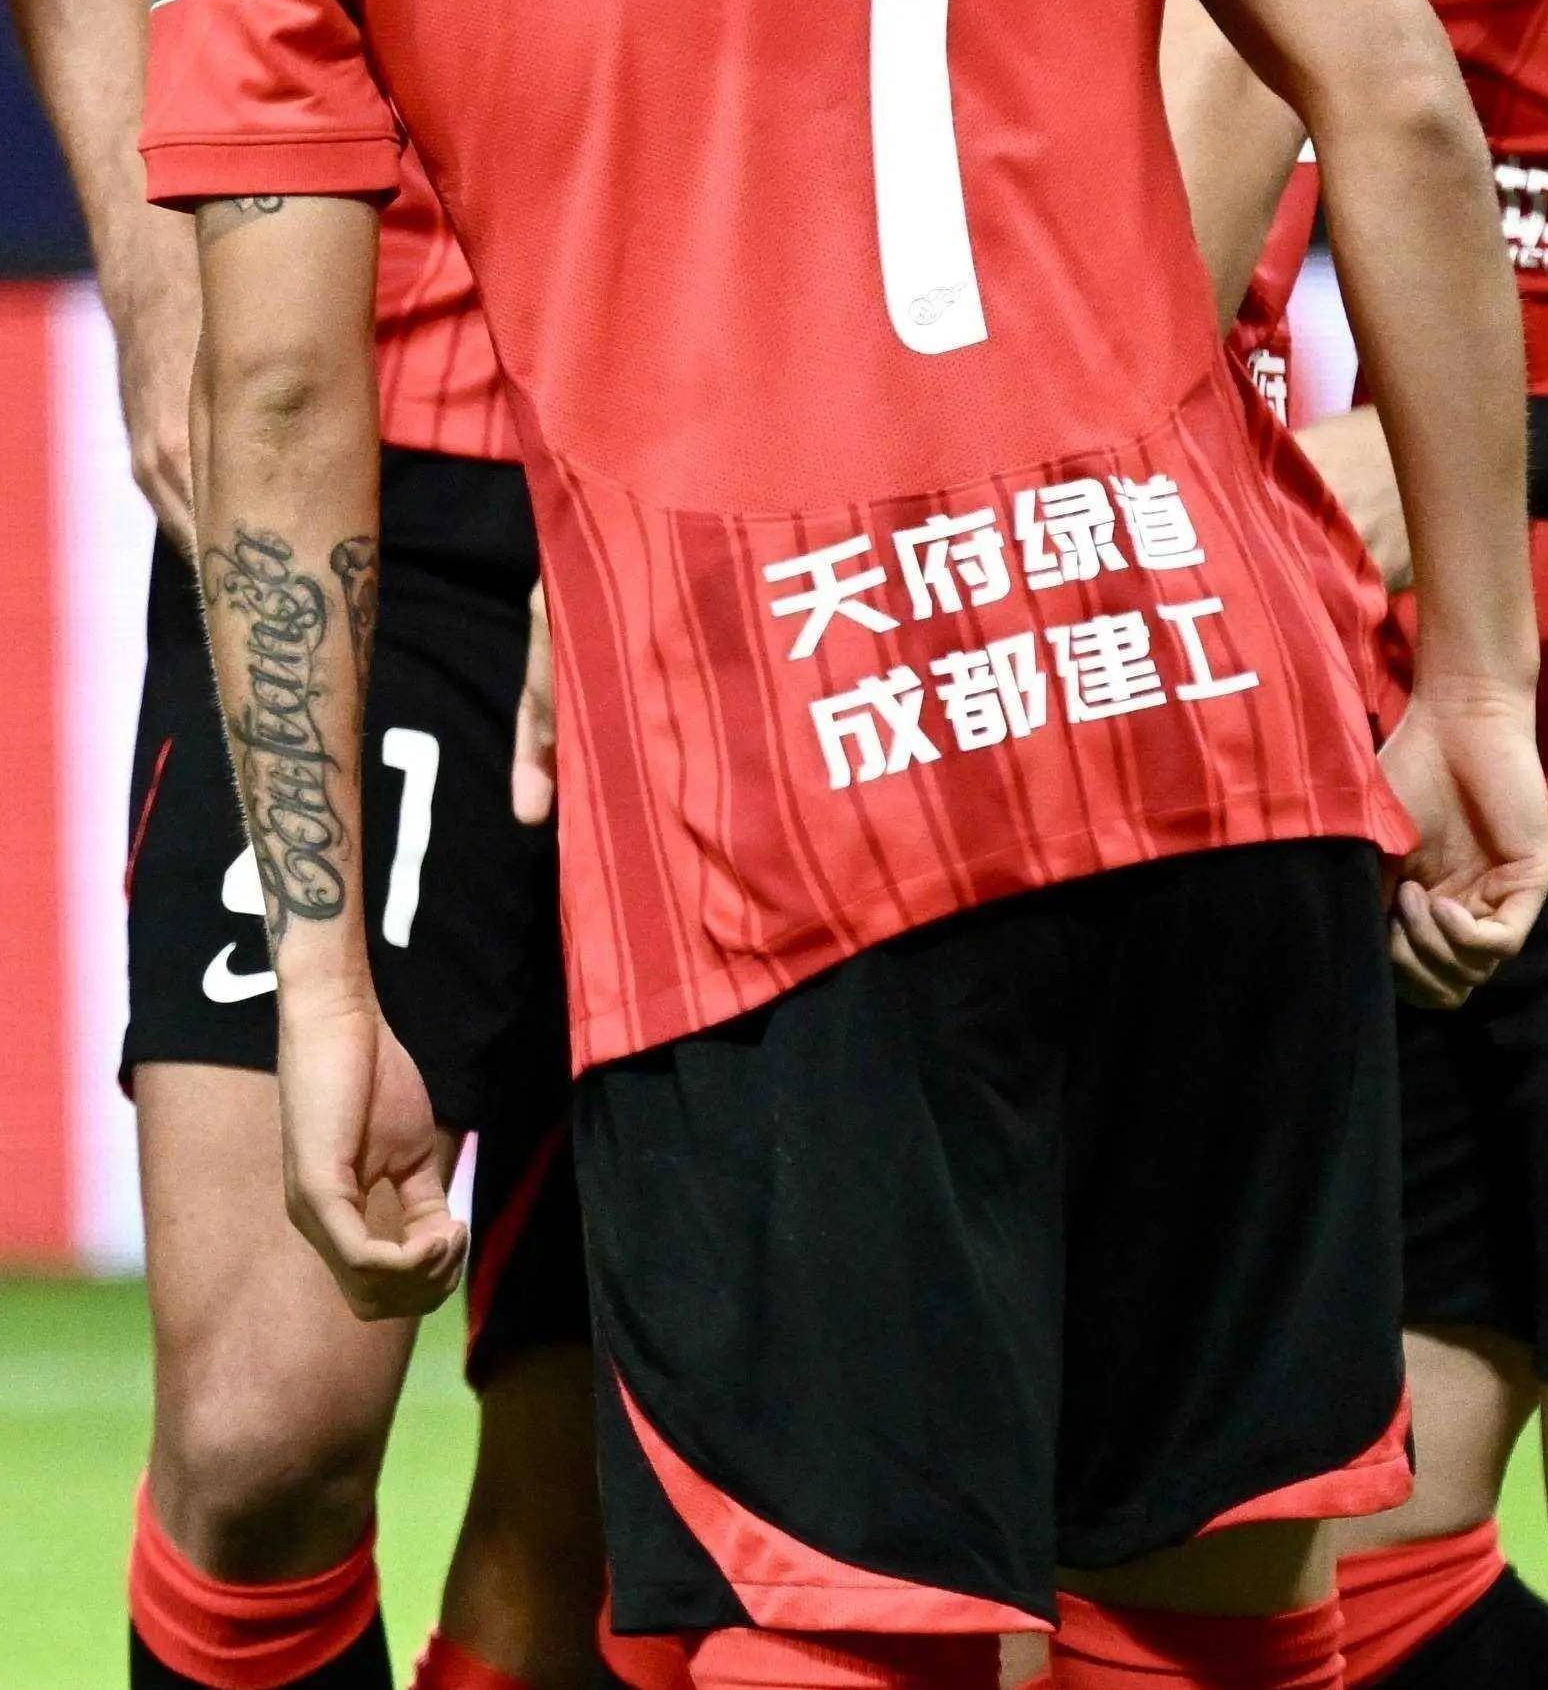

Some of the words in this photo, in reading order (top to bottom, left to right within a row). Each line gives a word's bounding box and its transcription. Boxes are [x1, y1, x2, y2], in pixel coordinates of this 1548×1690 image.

[762, 473, 1207, 661] 天府绿道
[809, 596, 1261, 791] 成都建工
